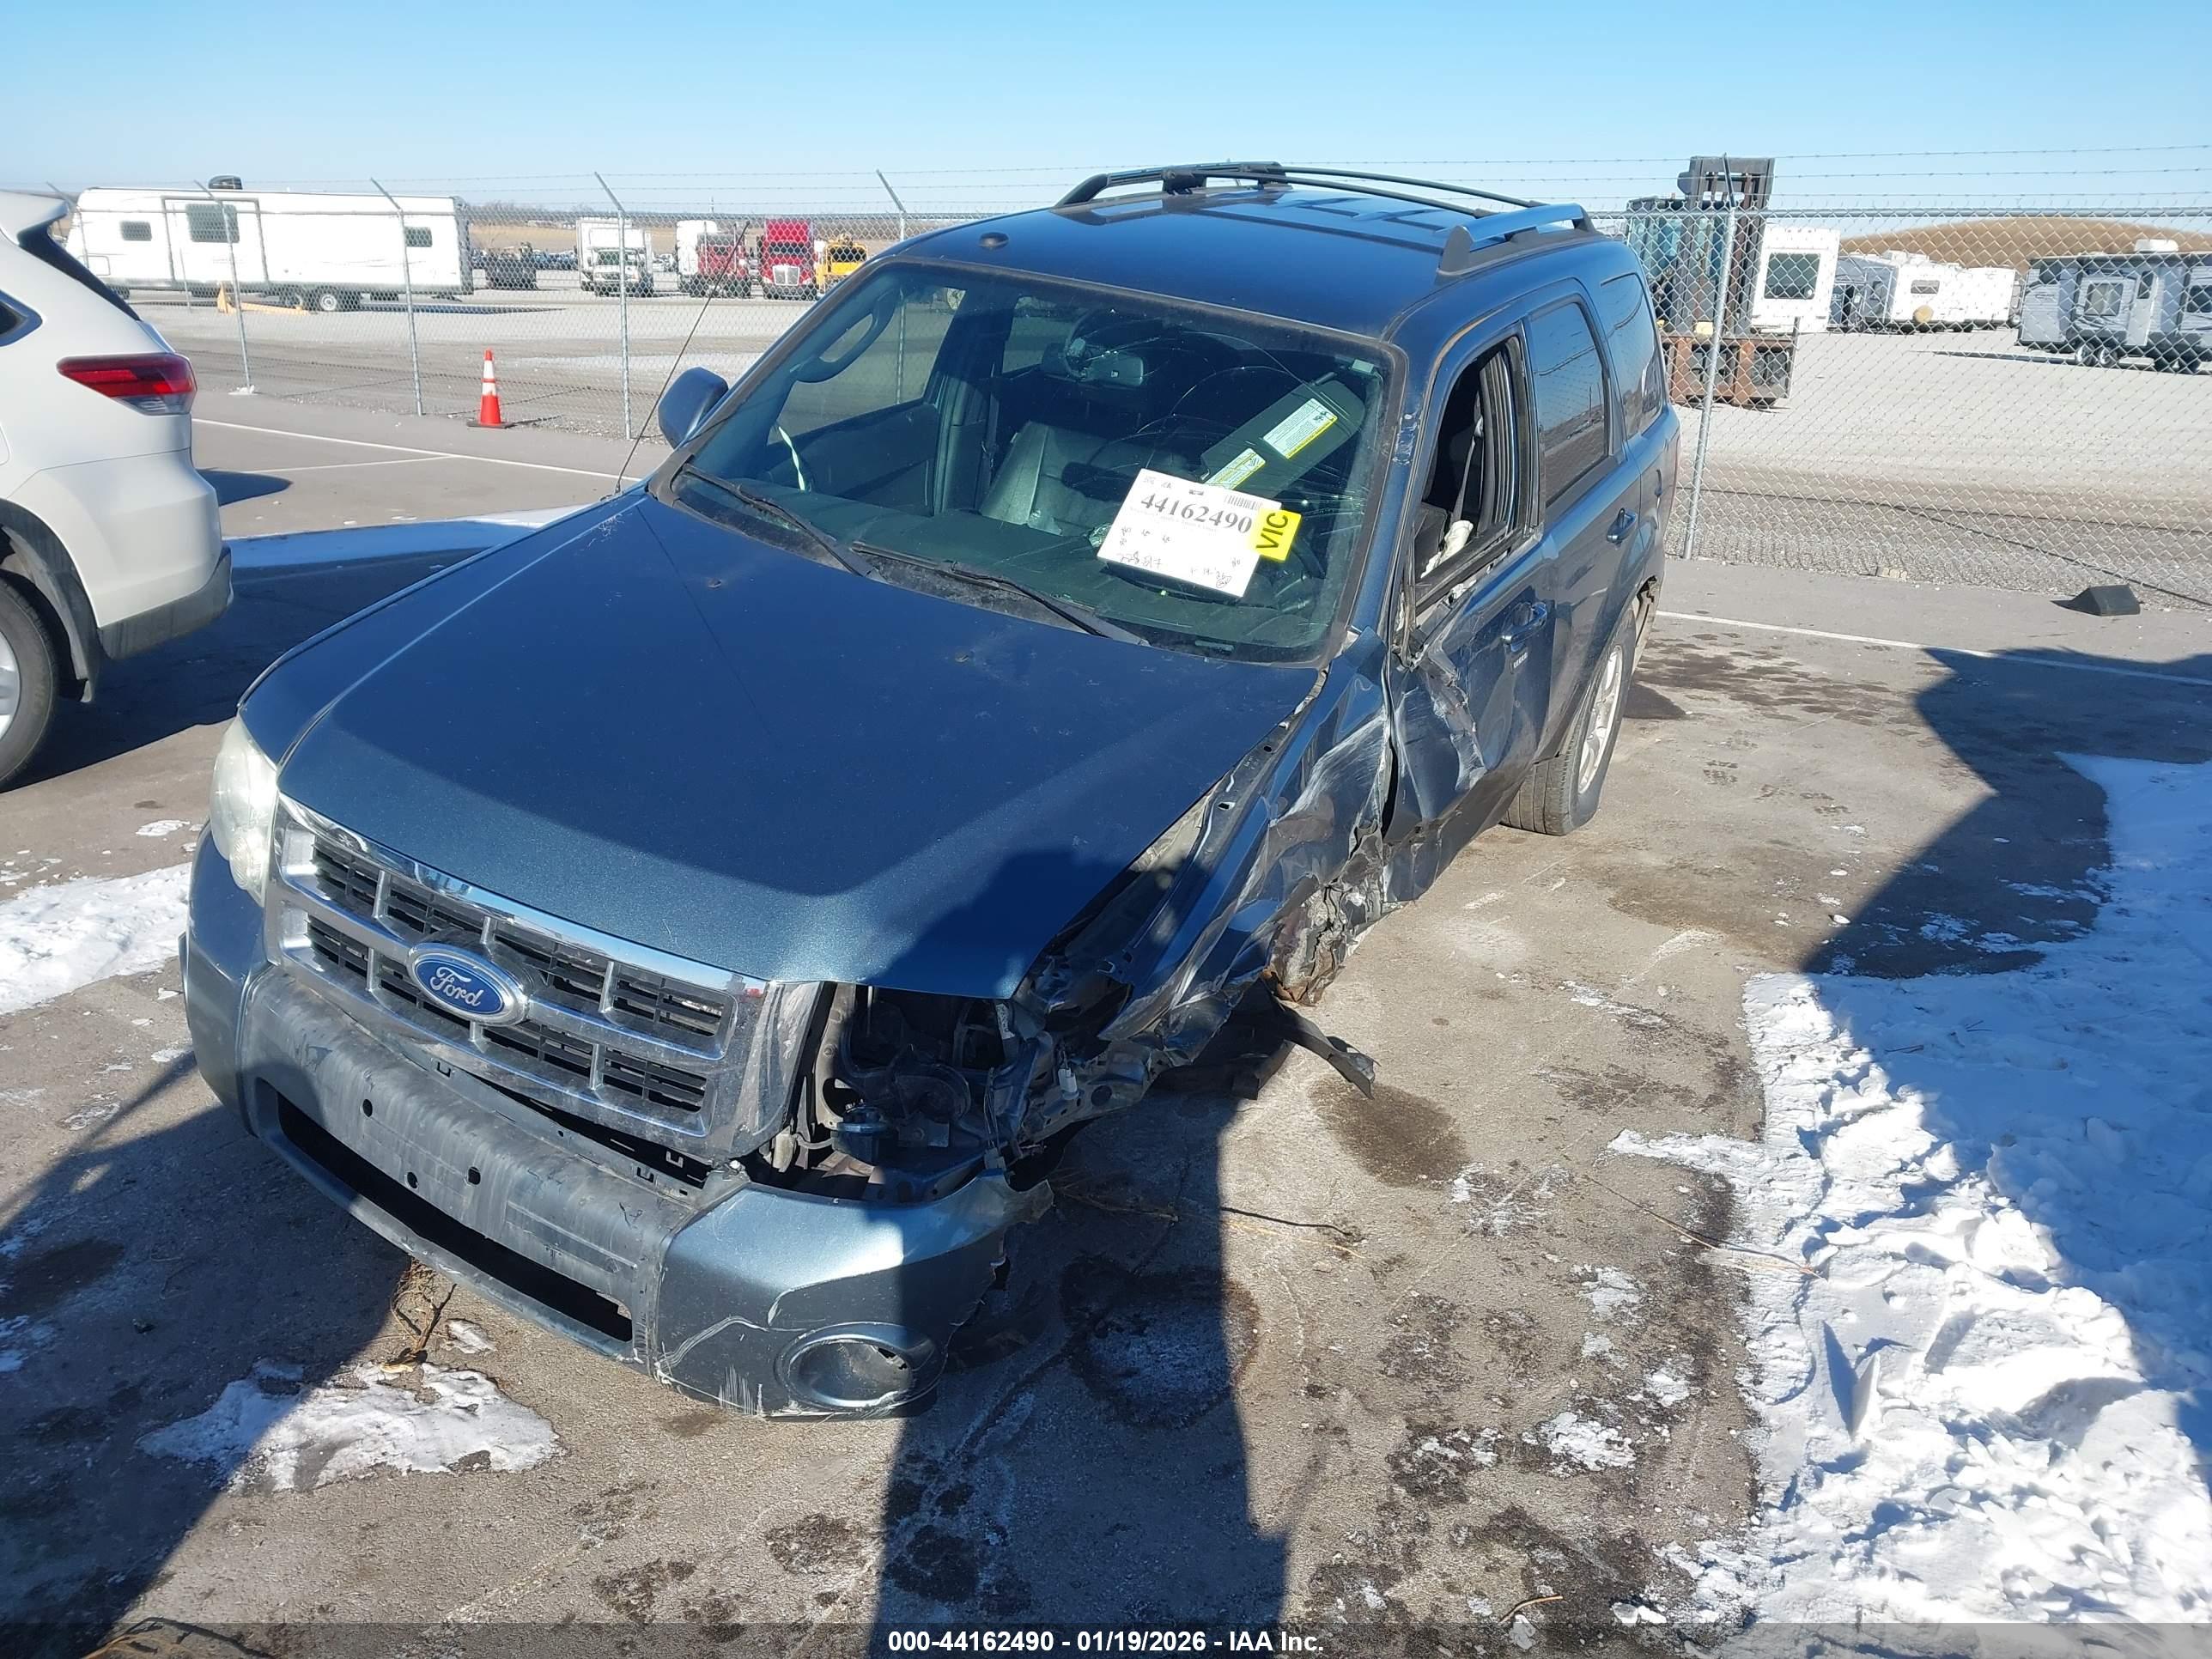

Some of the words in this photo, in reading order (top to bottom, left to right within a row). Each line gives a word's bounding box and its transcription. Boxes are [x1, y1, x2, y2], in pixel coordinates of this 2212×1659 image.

[1140, 492, 1253, 533] 44162490
[1255, 513, 1289, 549] VIC
[429, 966, 484, 1006] Ford
